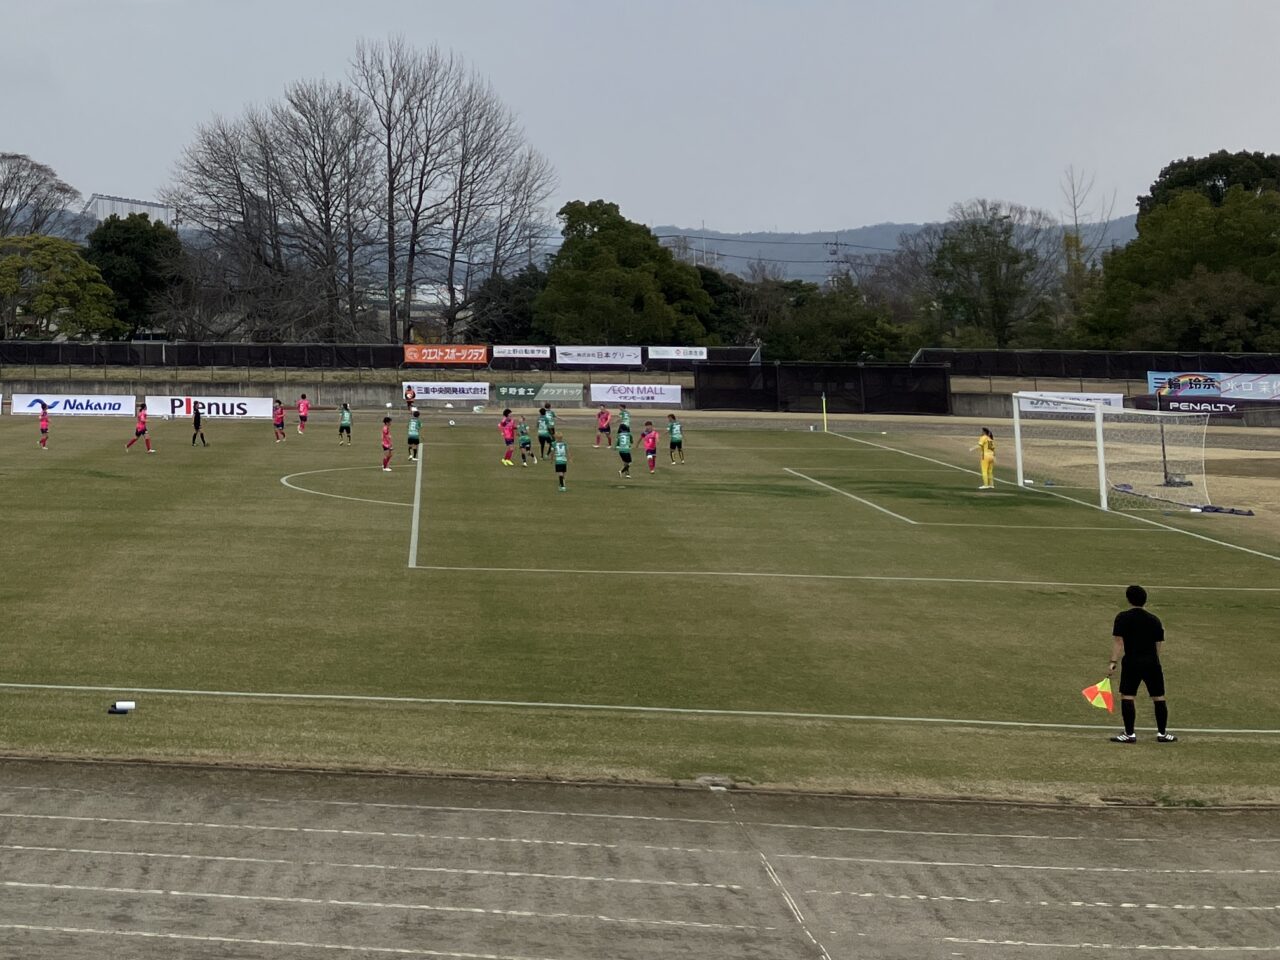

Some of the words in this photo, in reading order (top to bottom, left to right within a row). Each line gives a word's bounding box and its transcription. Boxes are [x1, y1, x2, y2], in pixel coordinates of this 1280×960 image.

[1153, 377, 1180, 390] 三輪
[636, 386, 665, 395] MALL
[63, 398, 121, 411] Nakano
[170, 397, 248, 416] Plenus
[1169, 402, 1236, 412] PENALTY
